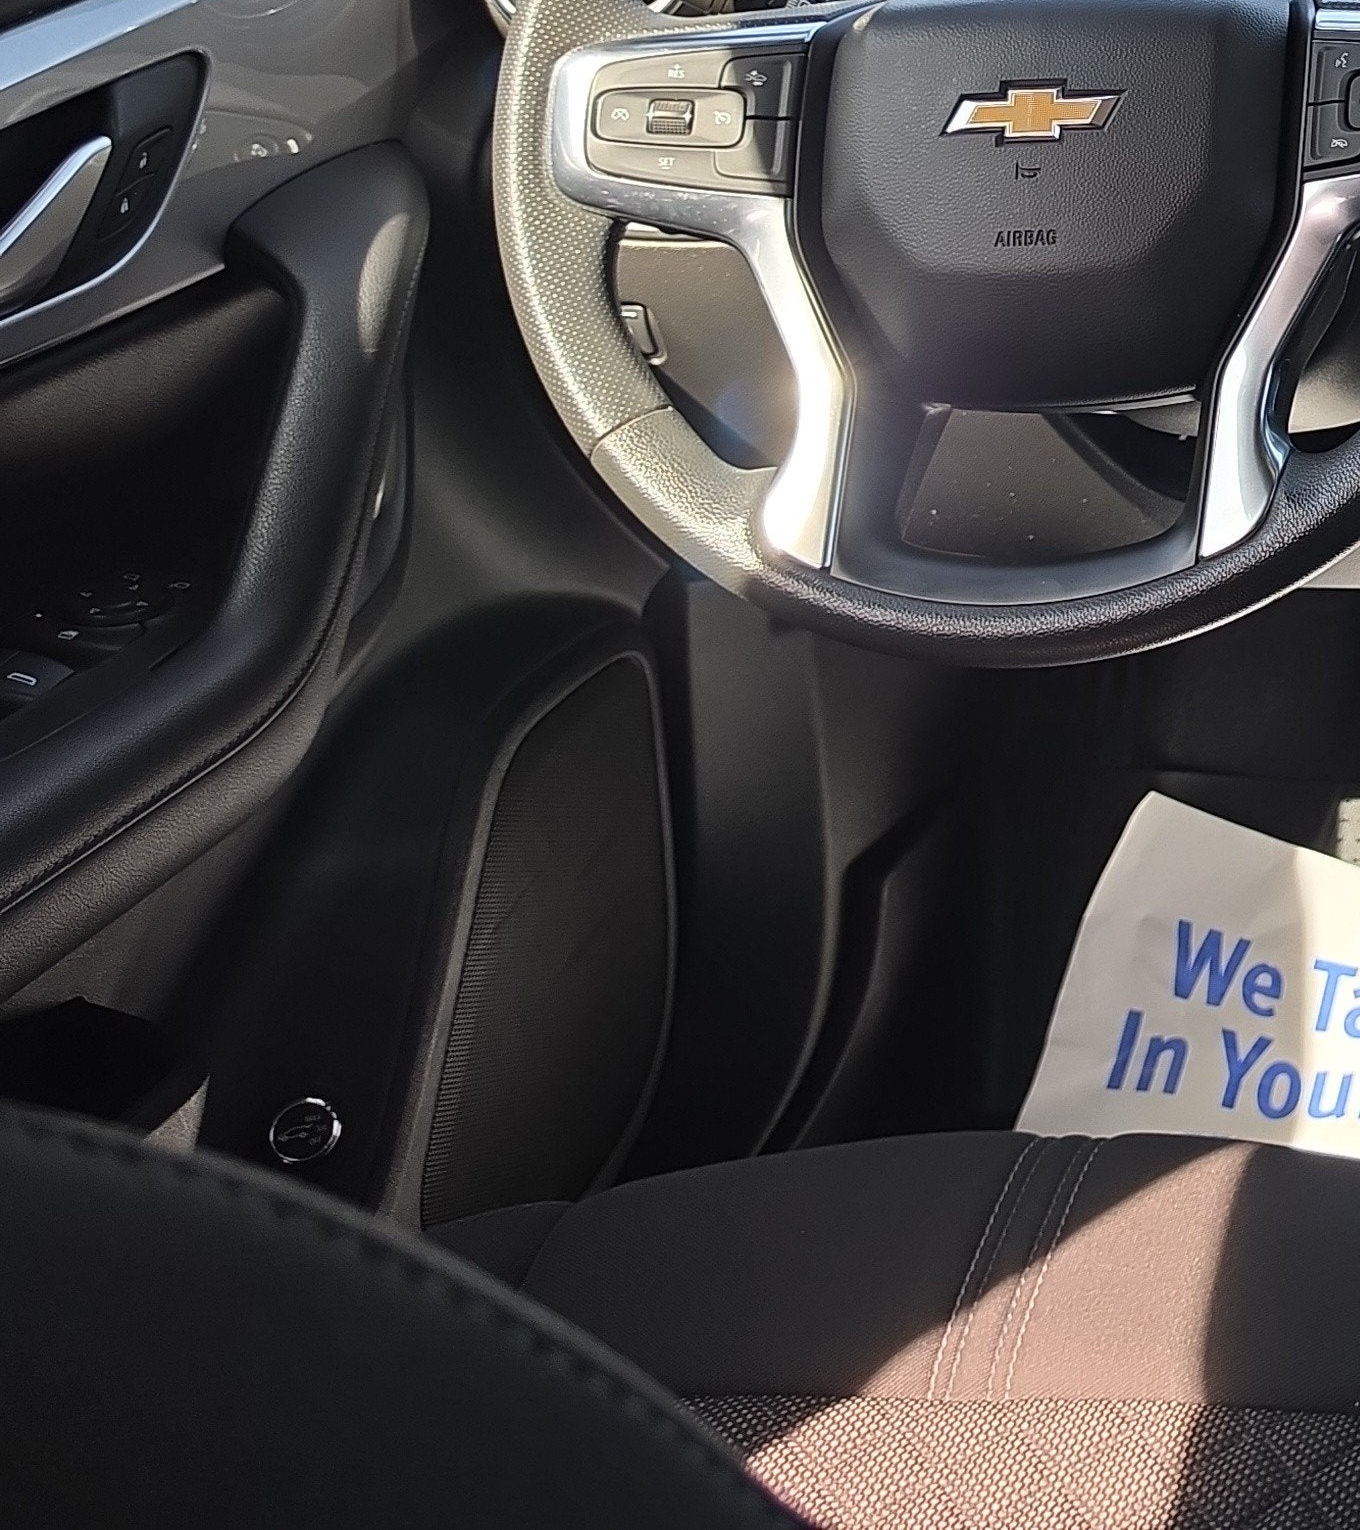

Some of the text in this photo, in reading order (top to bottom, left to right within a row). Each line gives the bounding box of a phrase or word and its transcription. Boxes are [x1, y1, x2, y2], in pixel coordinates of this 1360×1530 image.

[668, 69, 685, 79] RES
[657, 157, 676, 167] SET
[994, 229, 1057, 247] AIRBAG
[1171, 917, 1284, 1020] We
[1104, 1007, 1188, 1097] In
